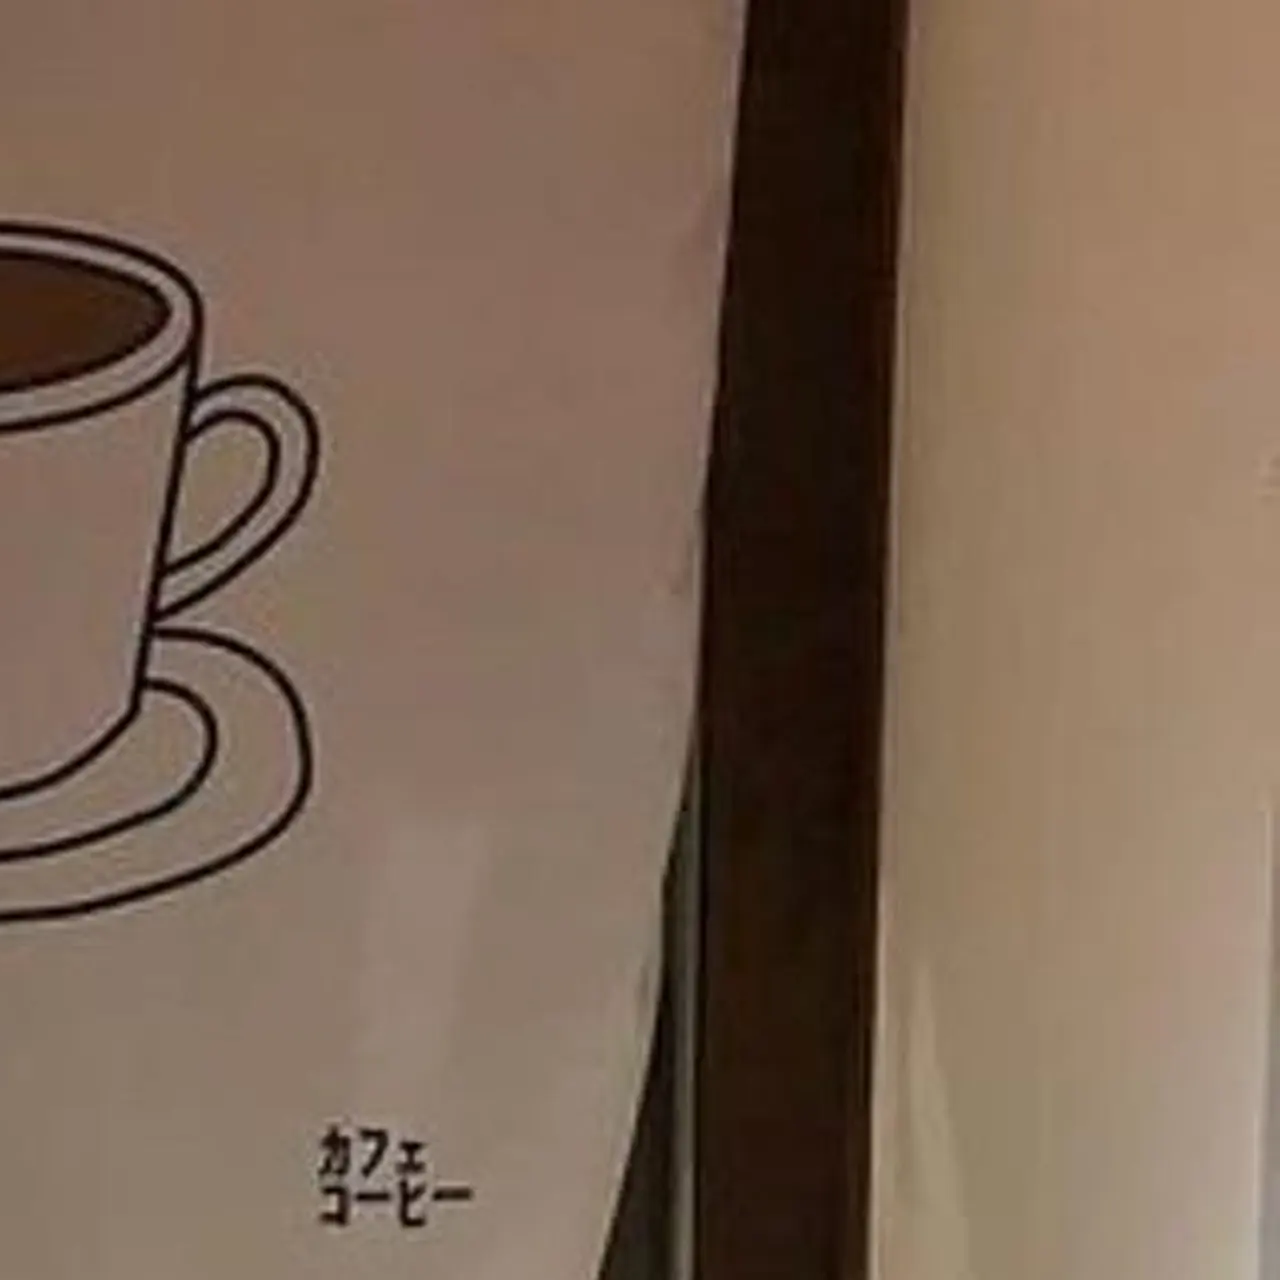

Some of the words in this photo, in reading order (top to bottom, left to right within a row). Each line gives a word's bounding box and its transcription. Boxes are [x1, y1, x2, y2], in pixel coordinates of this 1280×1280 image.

[318, 1124, 428, 1178] カフェ
[319, 1180, 475, 1230] コーヒー
